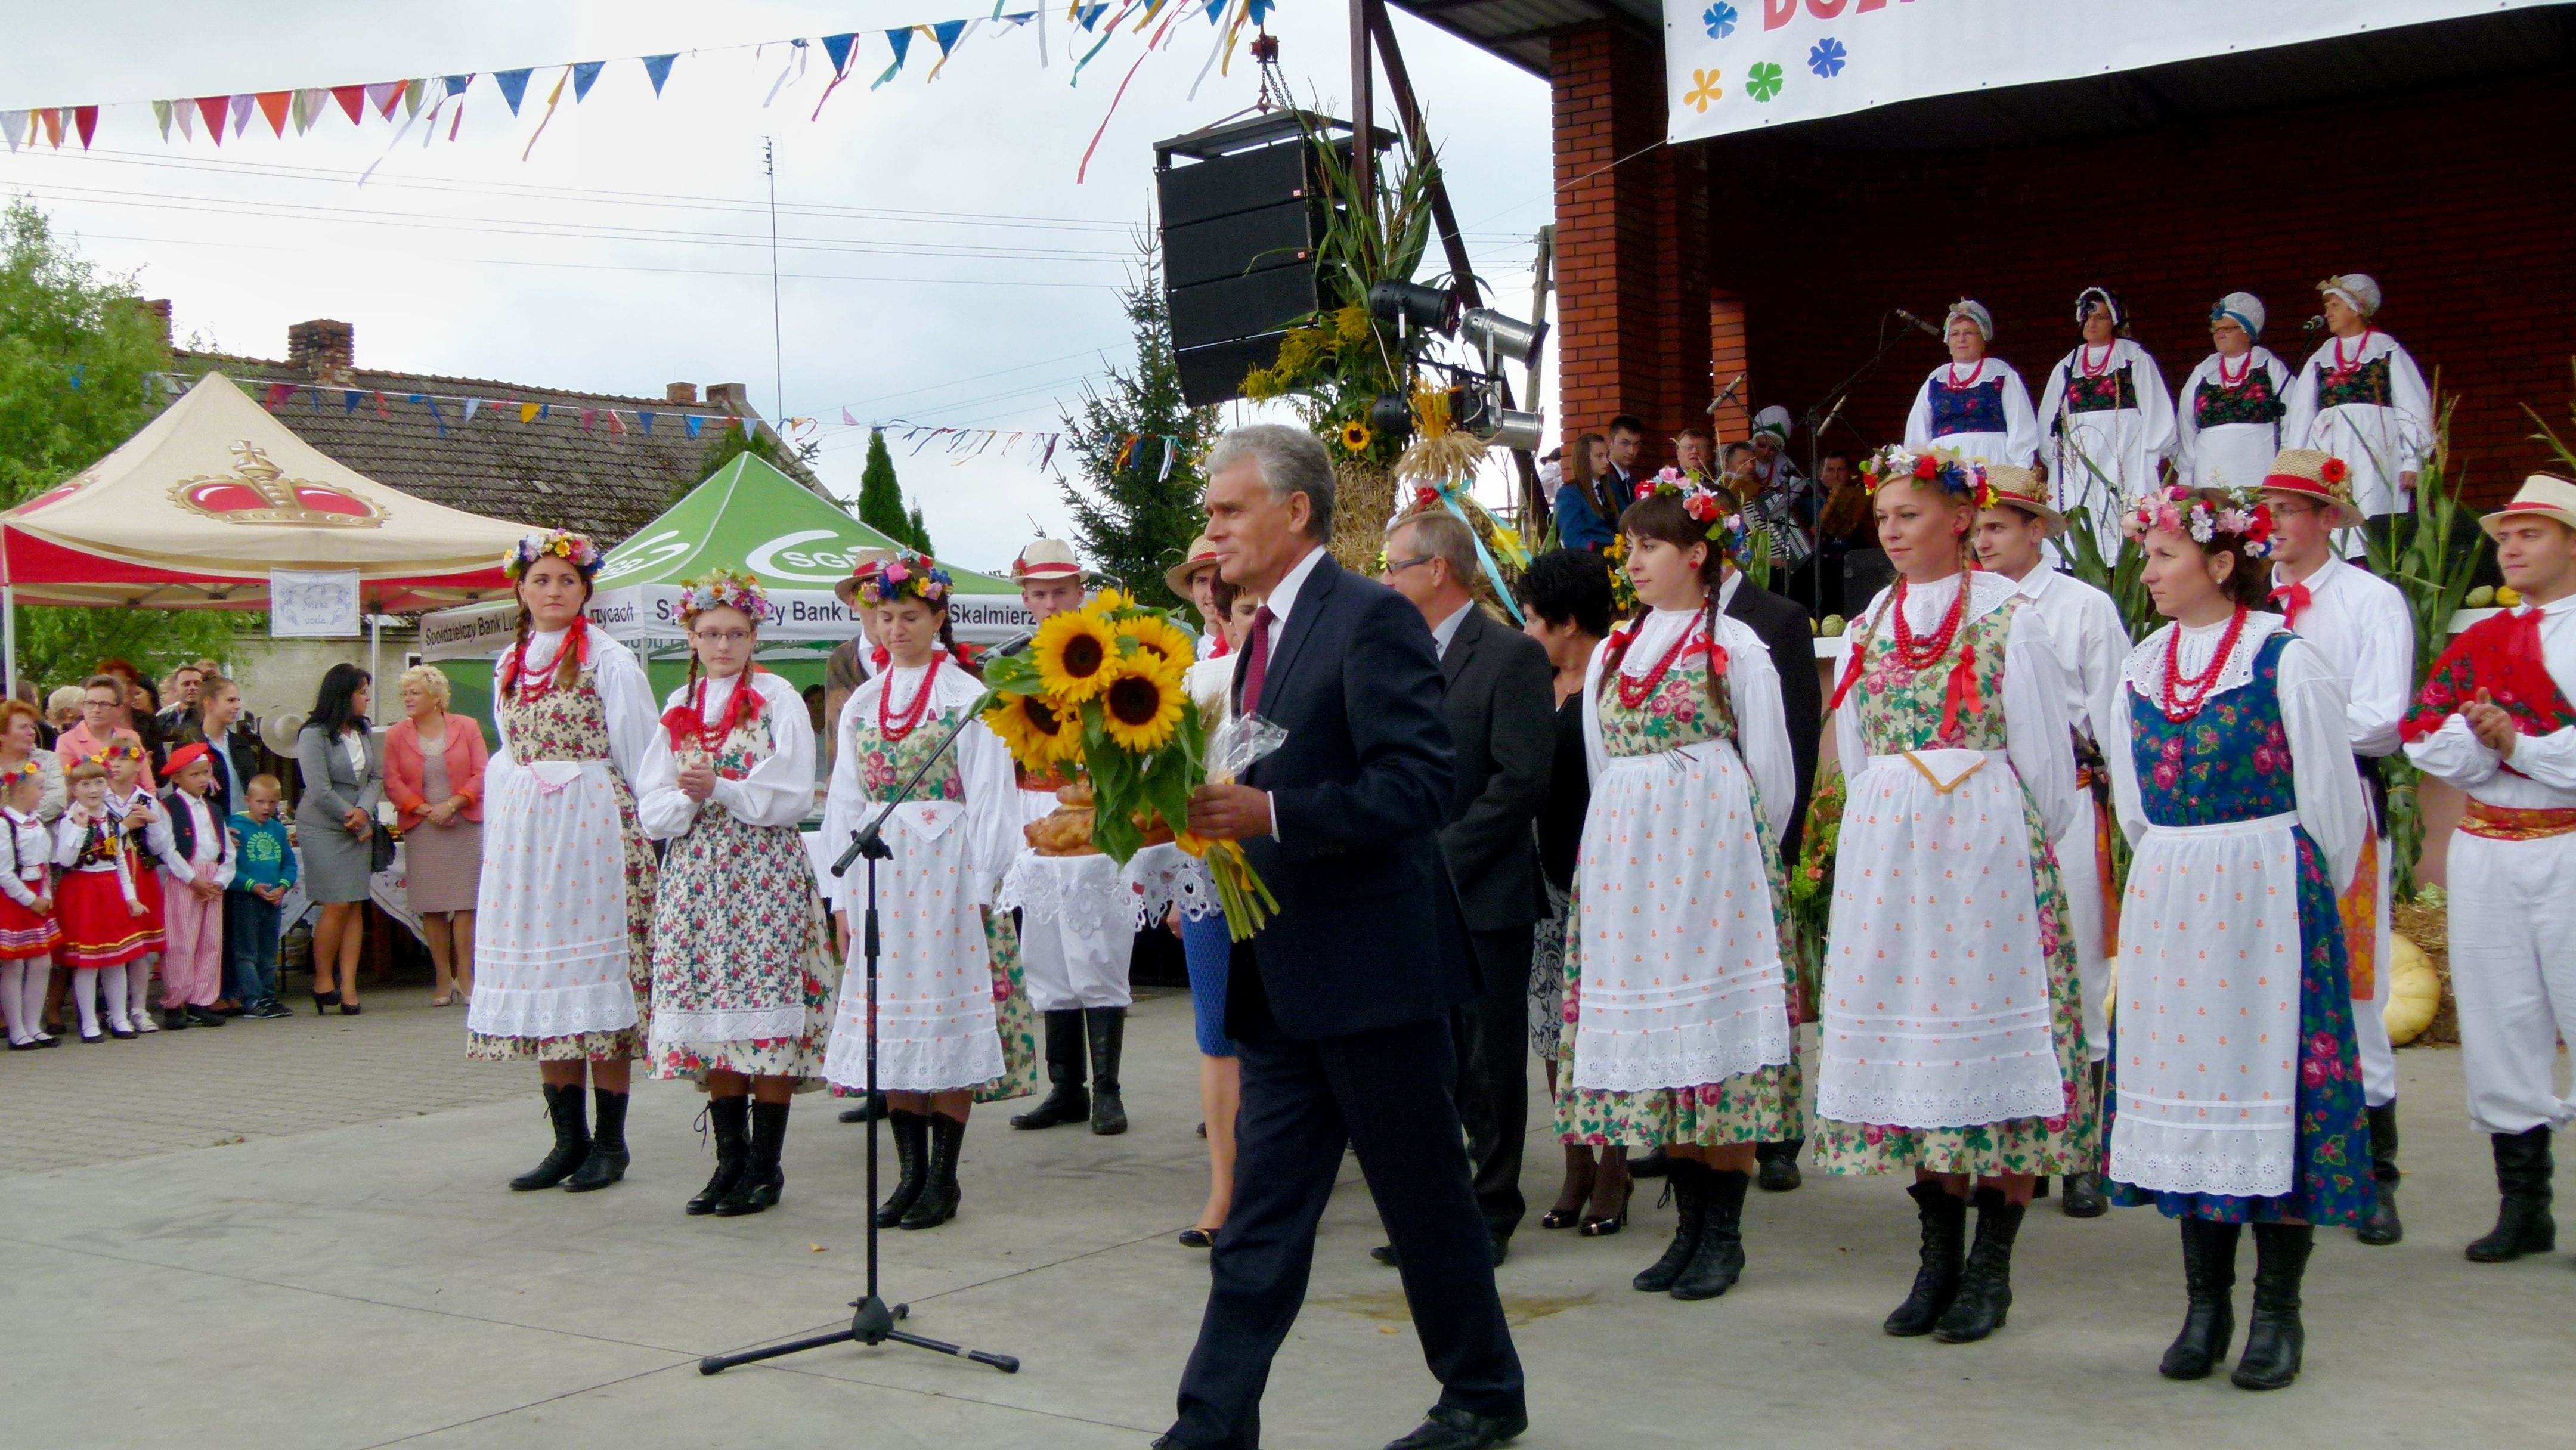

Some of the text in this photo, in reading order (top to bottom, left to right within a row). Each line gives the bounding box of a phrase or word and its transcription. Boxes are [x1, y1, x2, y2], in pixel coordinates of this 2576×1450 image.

[792, 600, 843, 622] Bank
[949, 603, 1037, 625] Skalmierz
[478, 614, 501, 636] Bank
